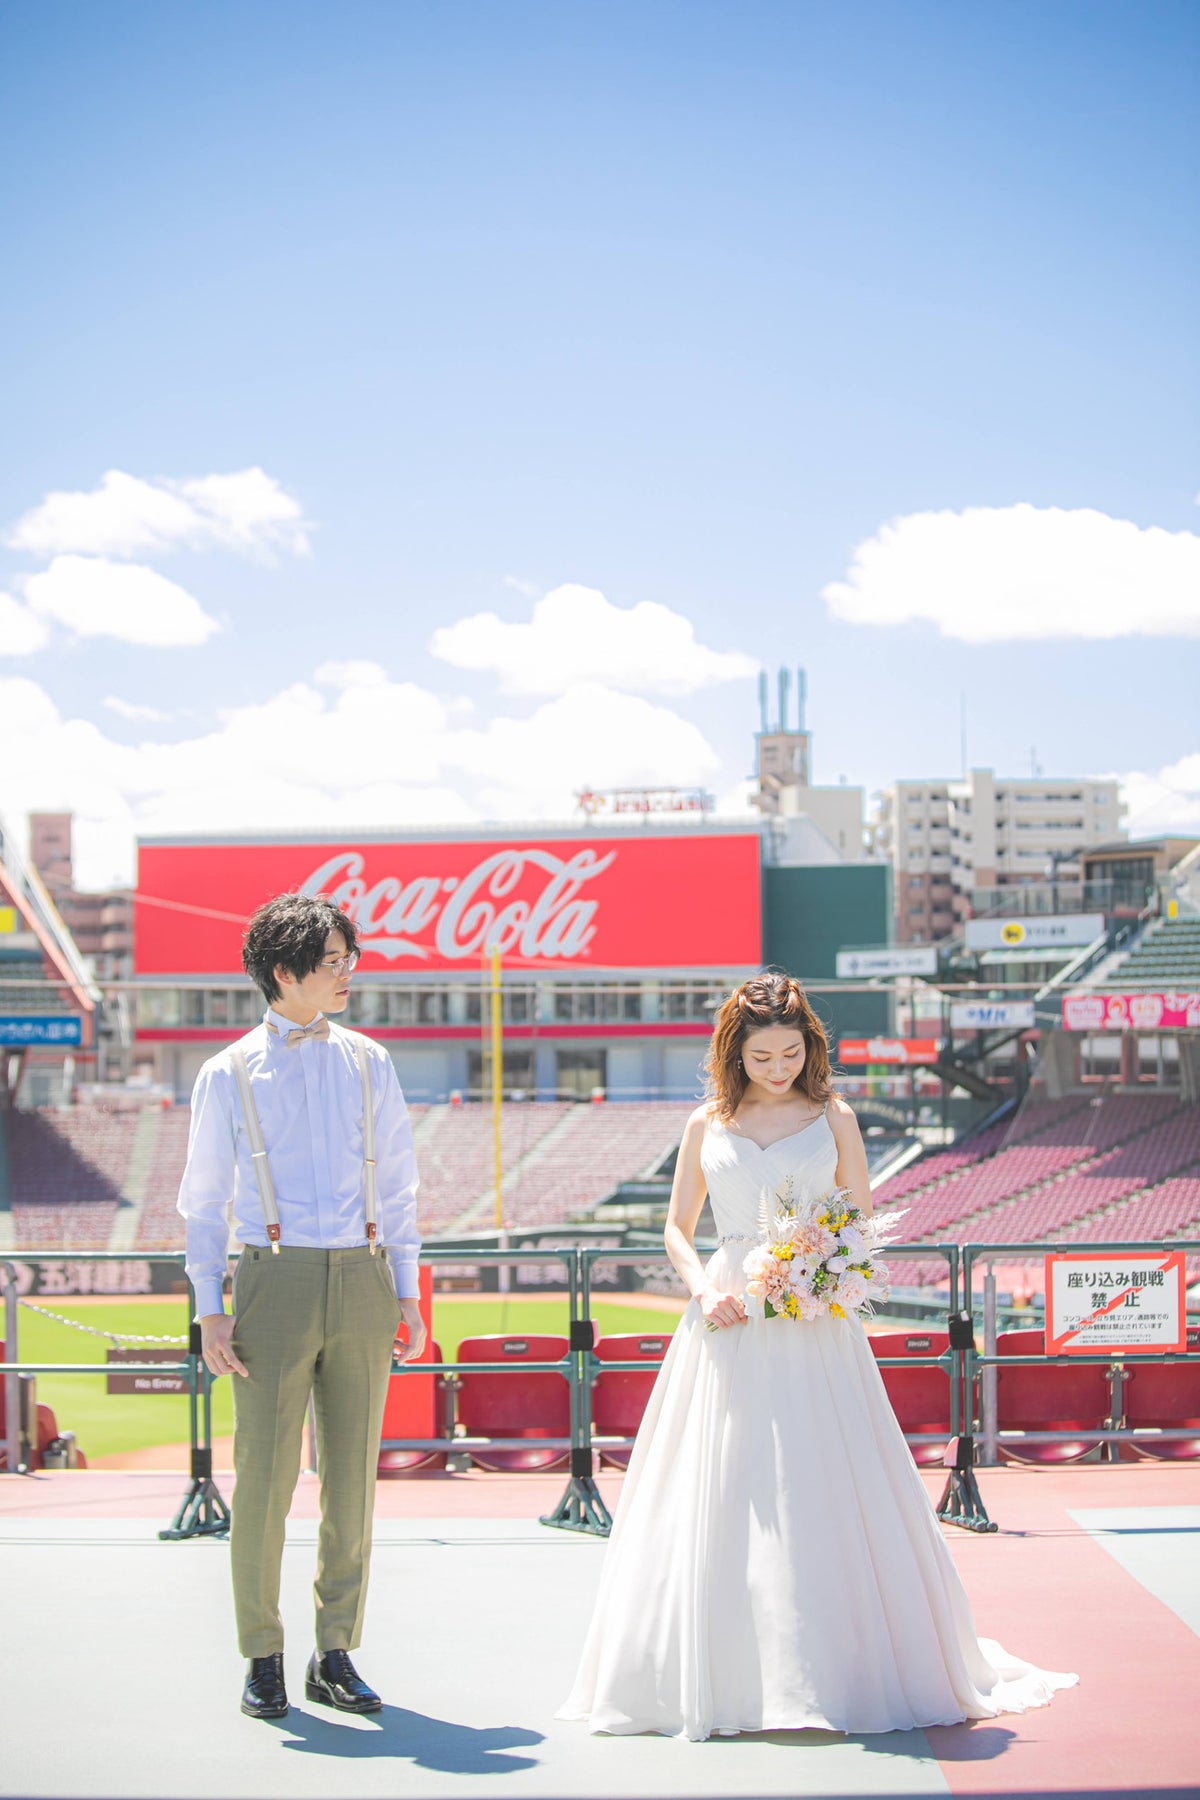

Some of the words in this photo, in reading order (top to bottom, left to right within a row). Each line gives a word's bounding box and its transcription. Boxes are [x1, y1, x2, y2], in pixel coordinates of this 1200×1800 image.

[299, 848, 617, 961] Coca-Cola
[1067, 1270, 1165, 1288] 座り込み観戦
[134, 1378, 151, 1389] No
[152, 1378, 183, 1390] Entry
